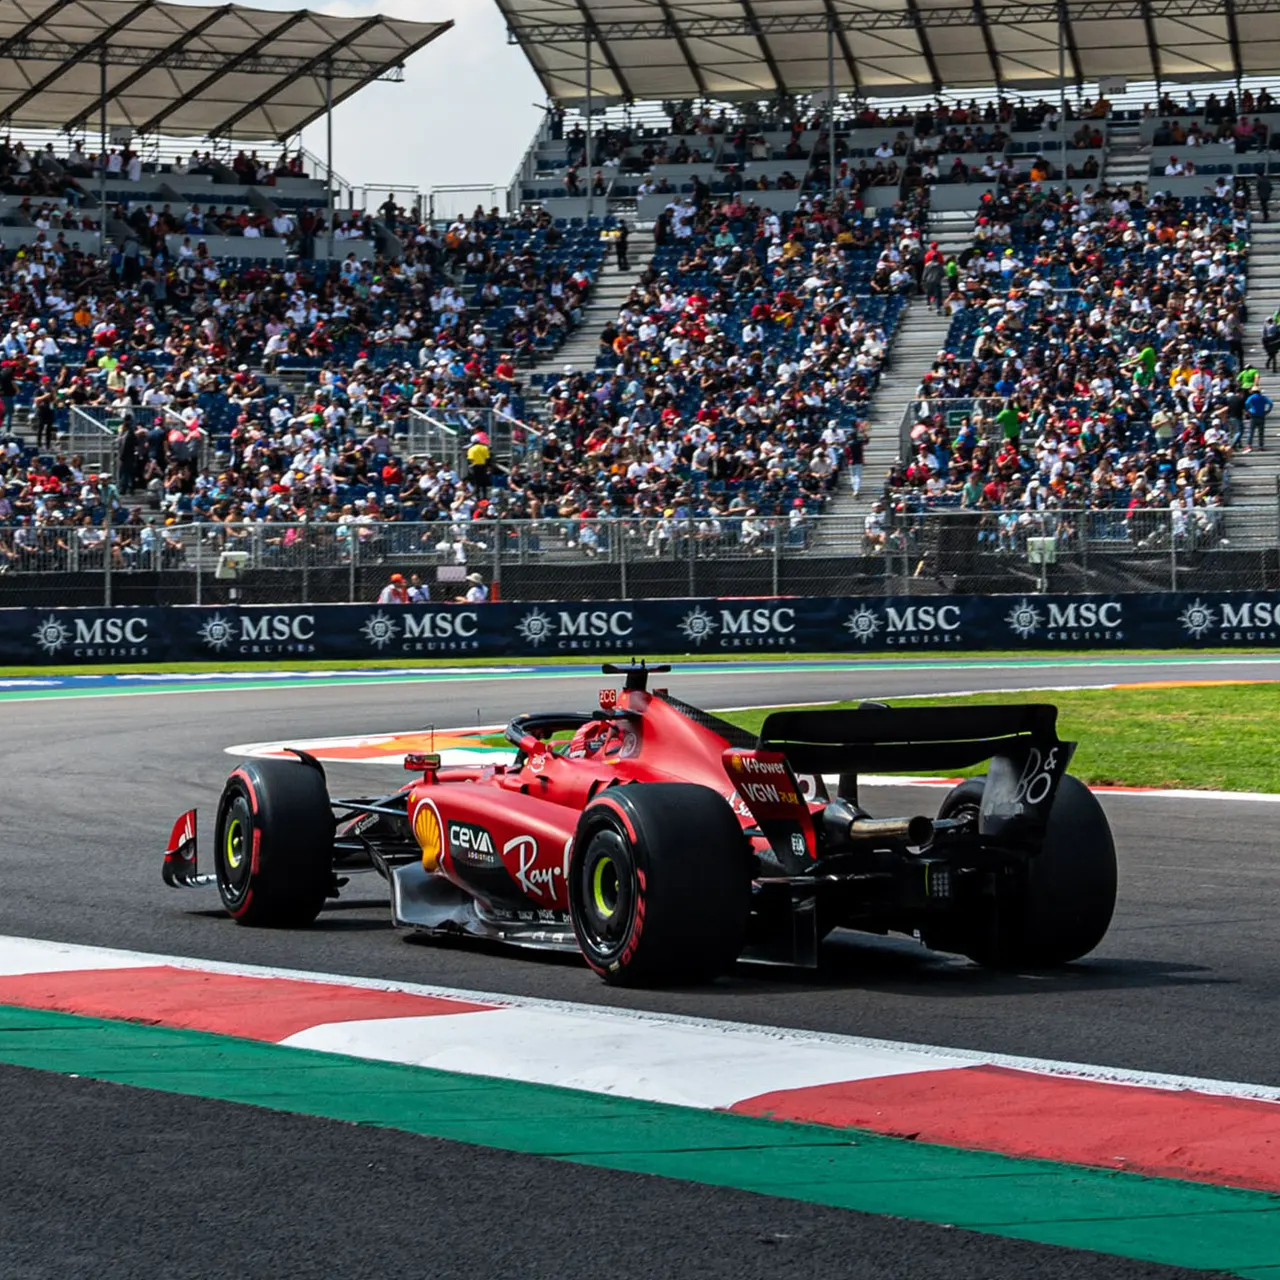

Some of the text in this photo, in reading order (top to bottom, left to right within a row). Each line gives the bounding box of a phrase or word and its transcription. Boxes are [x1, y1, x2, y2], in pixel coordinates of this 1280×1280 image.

[403, 611, 478, 638] MSC
[557, 610, 633, 636] MSC
[719, 607, 795, 634] MSC
[885, 605, 961, 632] MSC
[1047, 602, 1122, 628] MSC
[73, 617, 148, 644] MSC
[239, 614, 315, 641] MSC
[1047, 630, 1123, 640] CRUISES
[240, 643, 315, 653] CRUISES
[403, 640, 478, 650] CRUISES
[558, 639, 633, 648] CRUISES
[720, 636, 796, 646] CRUISES
[886, 634, 961, 644] CRUISES
[74, 647, 148, 656] CRUISES
[741, 782, 780, 802] VGW
